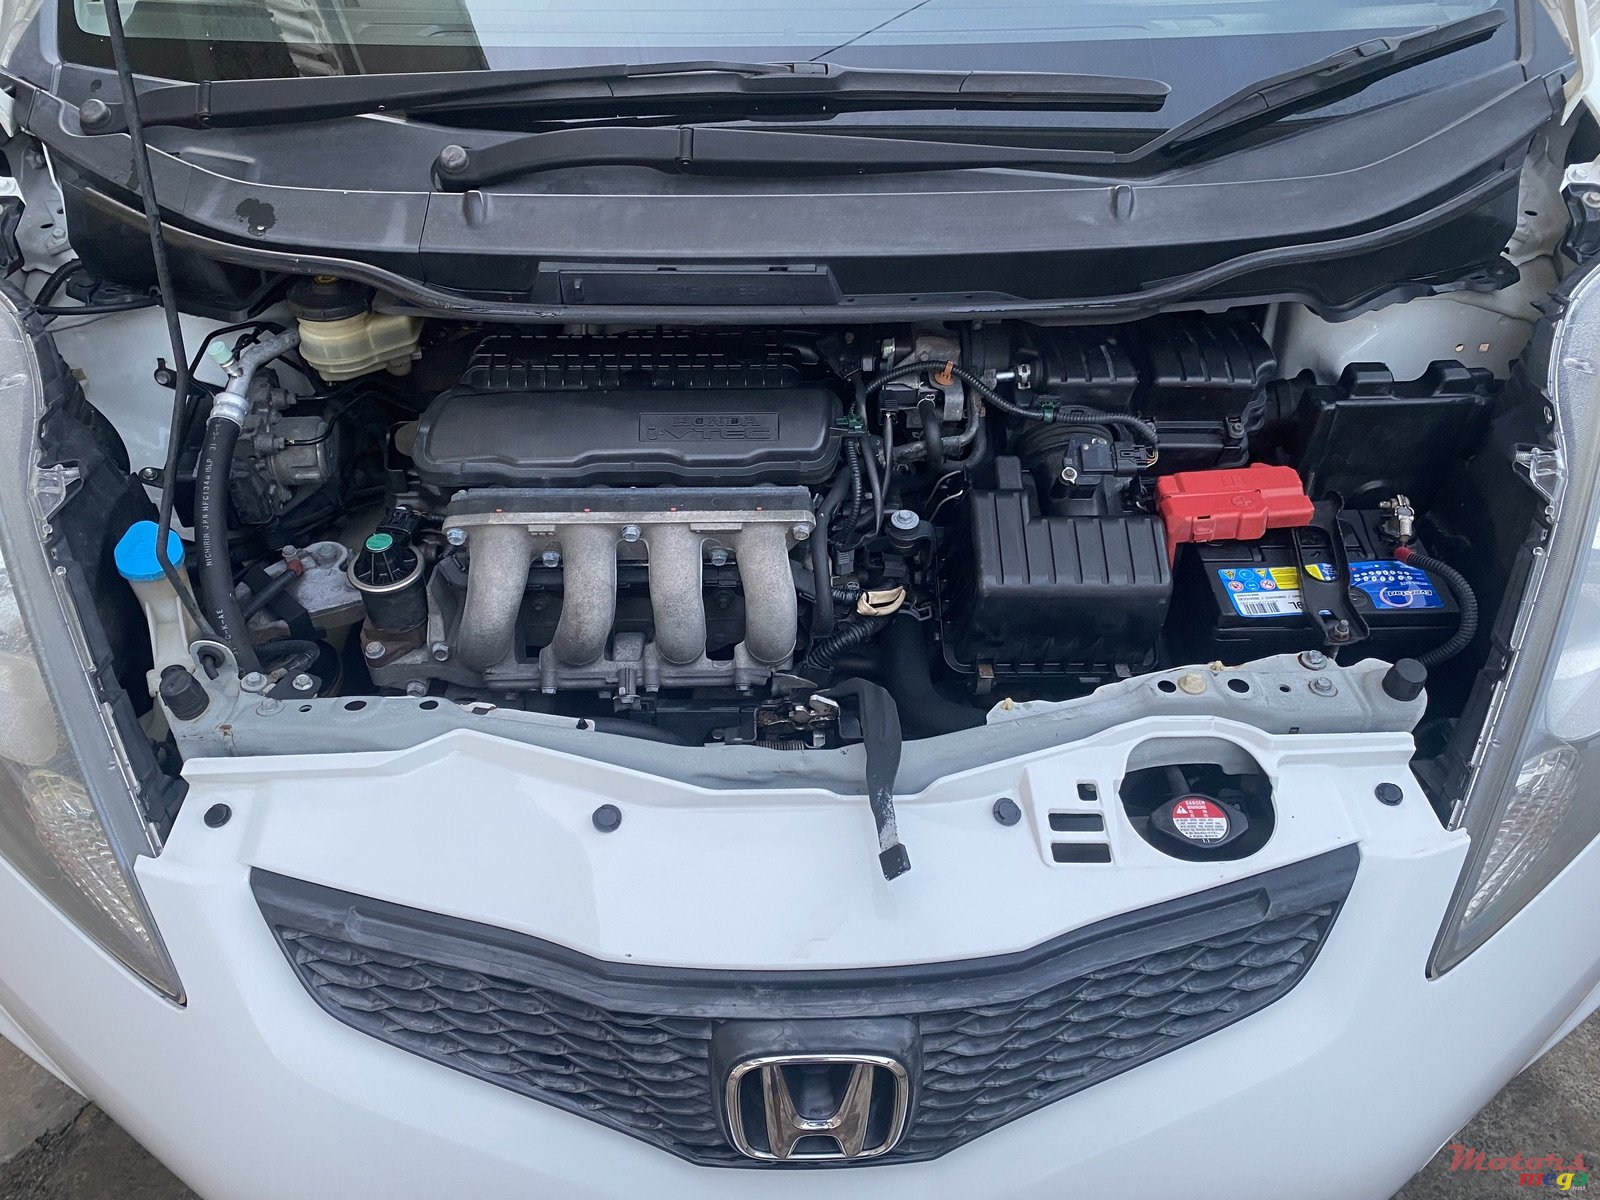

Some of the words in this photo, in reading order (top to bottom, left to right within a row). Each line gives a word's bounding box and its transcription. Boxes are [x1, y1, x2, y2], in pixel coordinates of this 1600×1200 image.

[671, 415, 760, 427] HONDA
[202, 514, 210, 530] JPN
[204, 533, 213, 567] NICHIRIN
